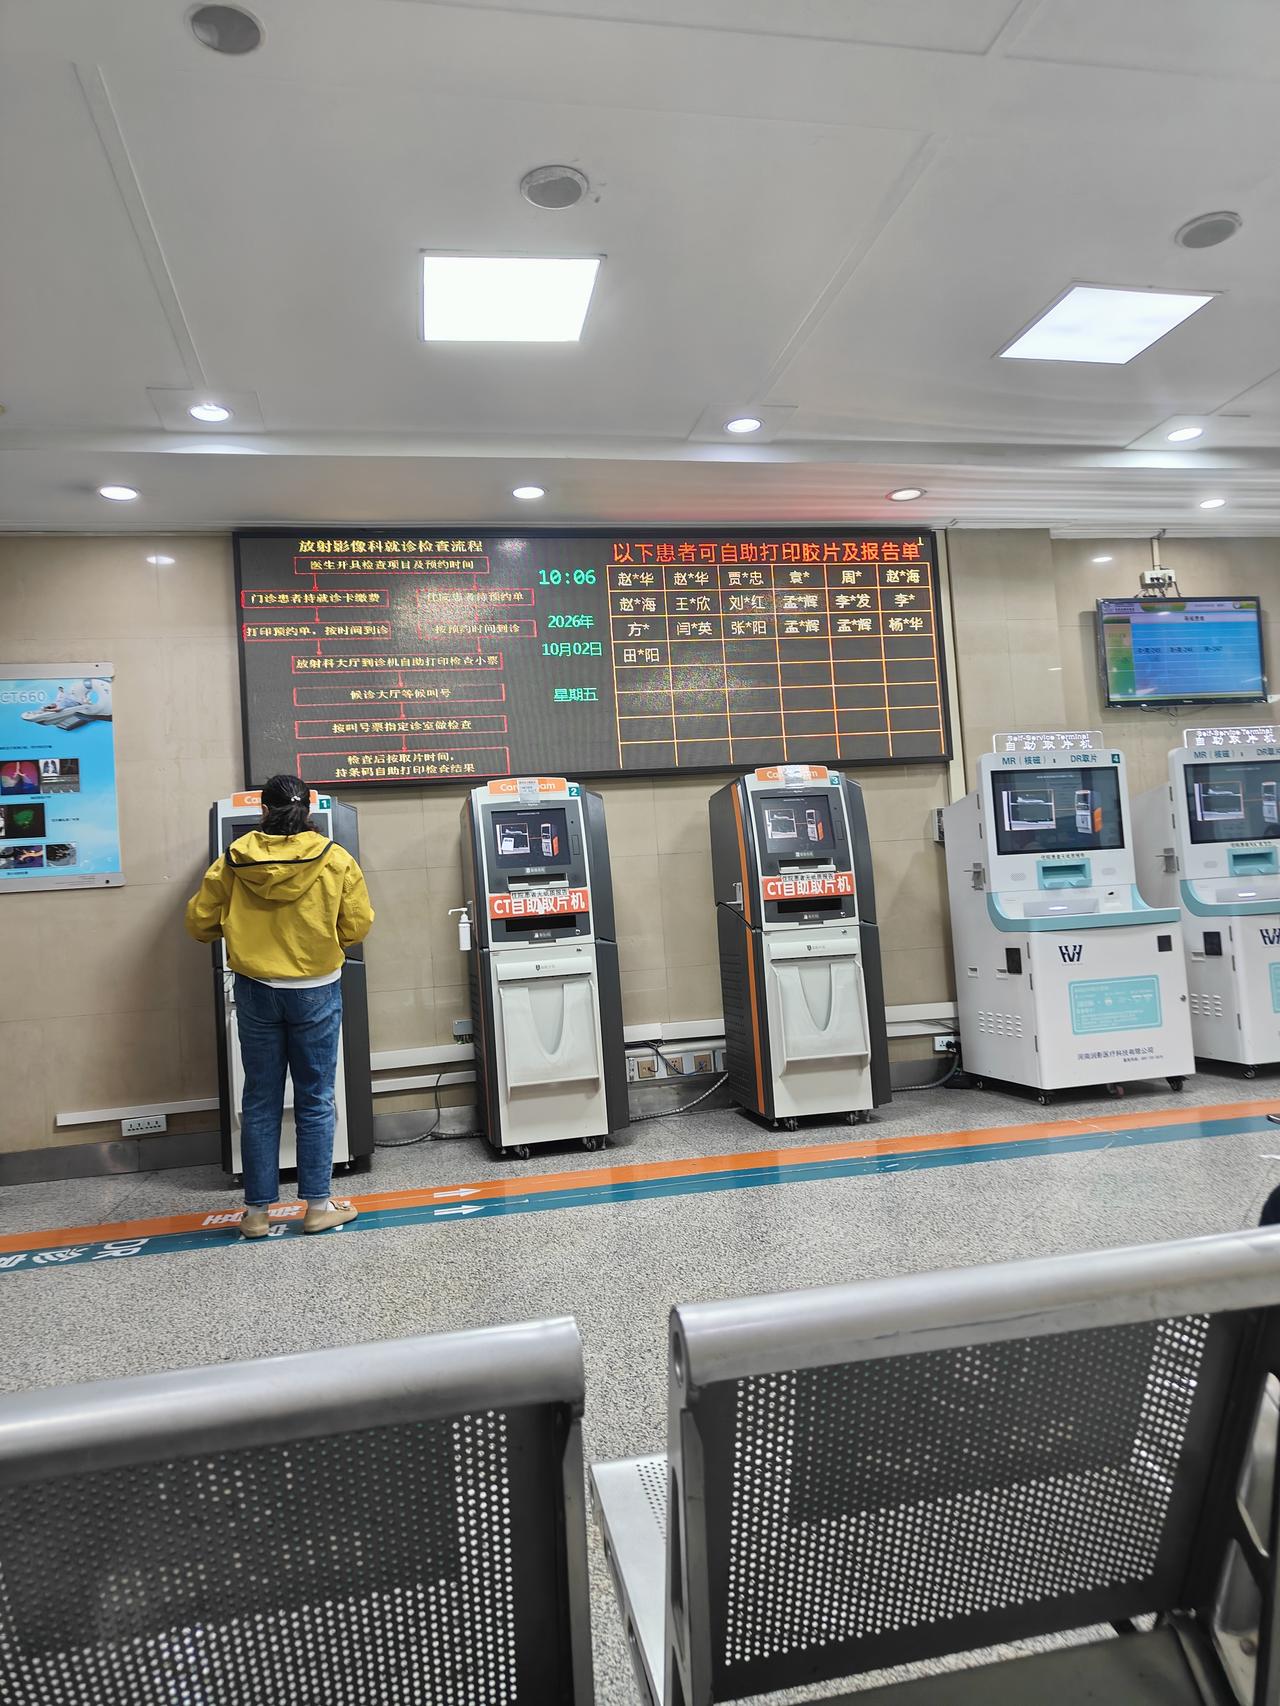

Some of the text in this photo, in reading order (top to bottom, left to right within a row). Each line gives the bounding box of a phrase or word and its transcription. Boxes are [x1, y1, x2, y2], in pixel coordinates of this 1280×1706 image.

[298, 540, 483, 553] 放射影像科就诊检查流程
[613, 542, 921, 563] 以下患者可自助打印胶片及报告单
[309, 560, 475, 571] 医生开具检查项目及预约时间
[538, 569, 597, 586] 10:06
[250, 593, 381, 605] 门诊患者持就诊卡缴费
[547, 614, 595, 630] 2026年
[541, 642, 603, 657] 10月02日
[349, 688, 452, 700] 候诊大厅等候叫号
[553, 688, 599, 703] 星期五
[1056, 733, 1089, 741] Terminal
[1006, 740, 1093, 751] 自助取片机
[832, 776, 838, 784] 3
[571, 788, 577, 796] 2
[321, 800, 327, 808] 1
[767, 876, 851, 896] CT自助取片机
[494, 892, 586, 914] CT自助取片机
